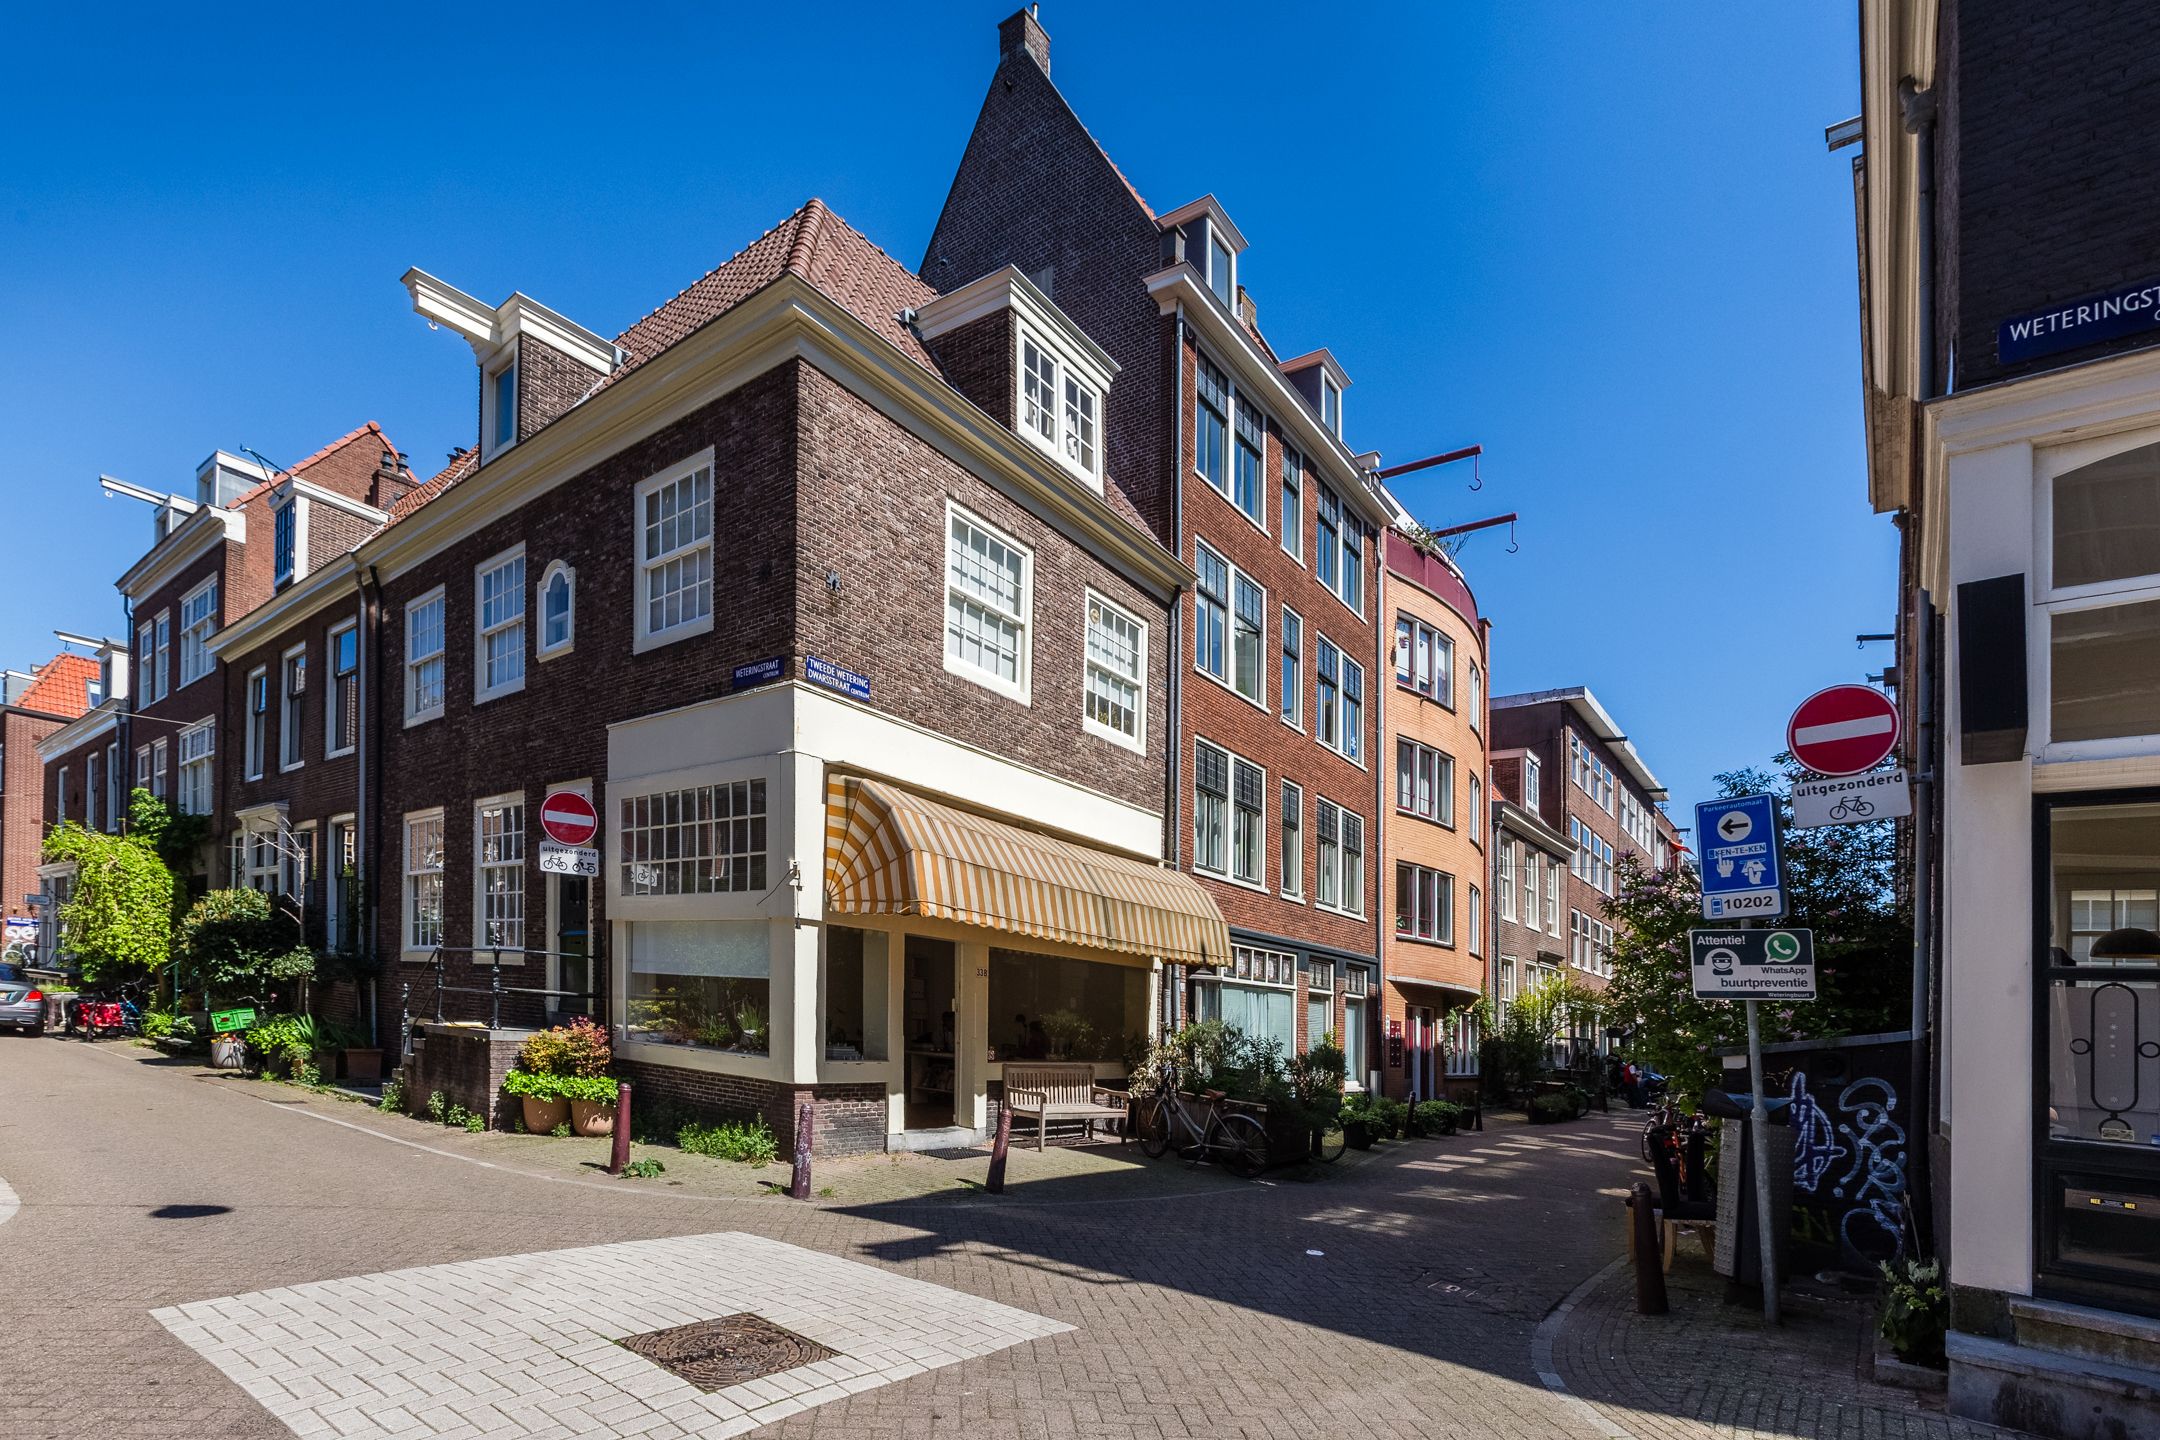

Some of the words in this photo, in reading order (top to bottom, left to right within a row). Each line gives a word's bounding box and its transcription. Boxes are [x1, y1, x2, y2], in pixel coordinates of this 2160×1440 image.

[735, 659, 779, 679] WETERINGSTRAAT
[809, 658, 835, 677] TWEEDE
[836, 669, 868, 689] WETERING
[808, 668, 850, 692] DWARSSTRAAT
[850, 687, 870, 699] CENTRUM
[1796, 772, 1903, 797] uitgezonderd
[1703, 799, 1763, 812] Parkeerautomaat
[542, 845, 596, 857] uitgezonderd
[1723, 895, 1773, 910] 10202
[1696, 935, 1746, 946] Attentie!
[1761, 966, 1807, 976] WhatsApp
[1720, 977, 1809, 990] buurtpreventie
